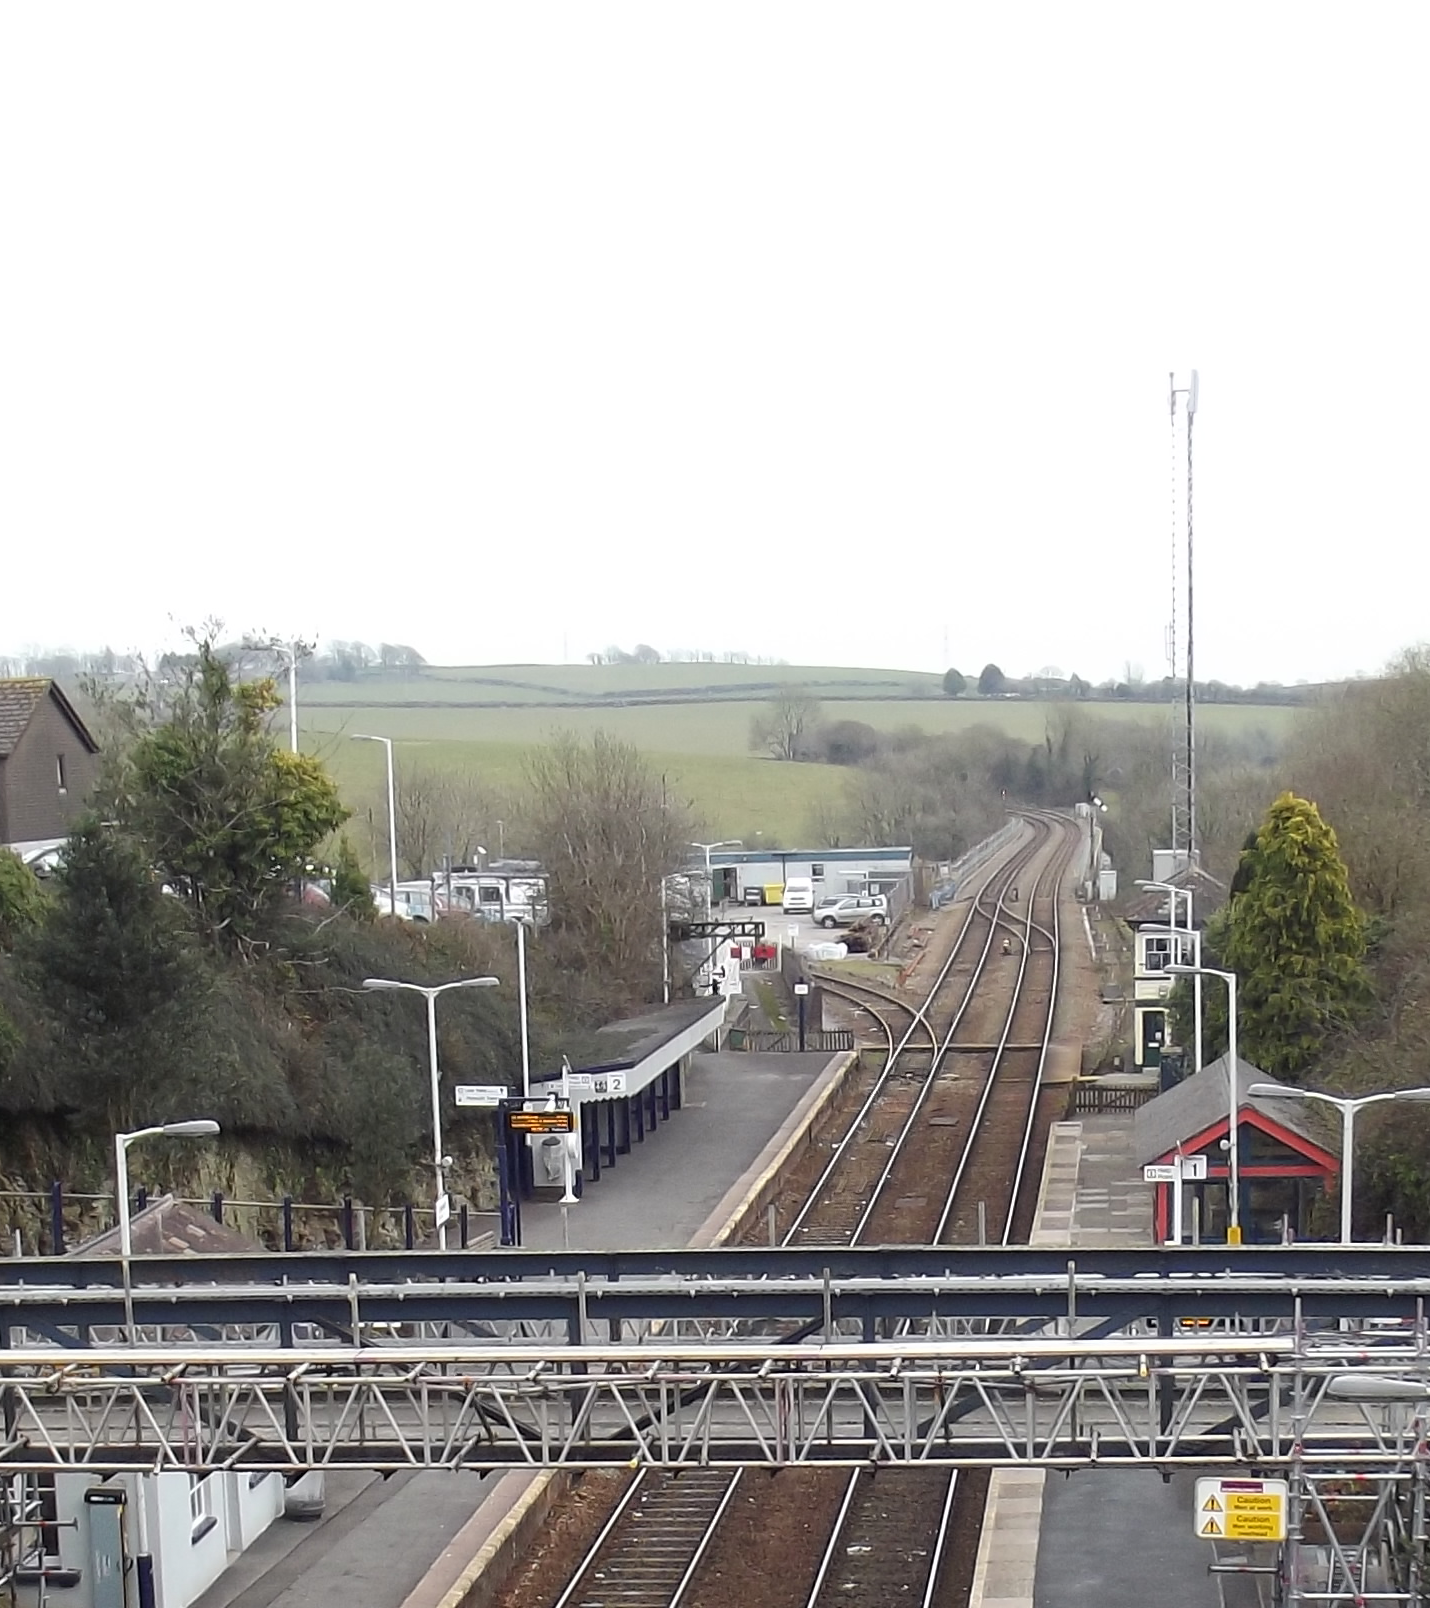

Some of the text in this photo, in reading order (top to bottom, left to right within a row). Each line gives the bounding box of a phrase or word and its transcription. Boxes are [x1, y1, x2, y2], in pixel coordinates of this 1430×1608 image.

[613, 1079, 621, 1090] 2
[1237, 1496, 1271, 1504] Caution
[1236, 1515, 1270, 1523] Caution
